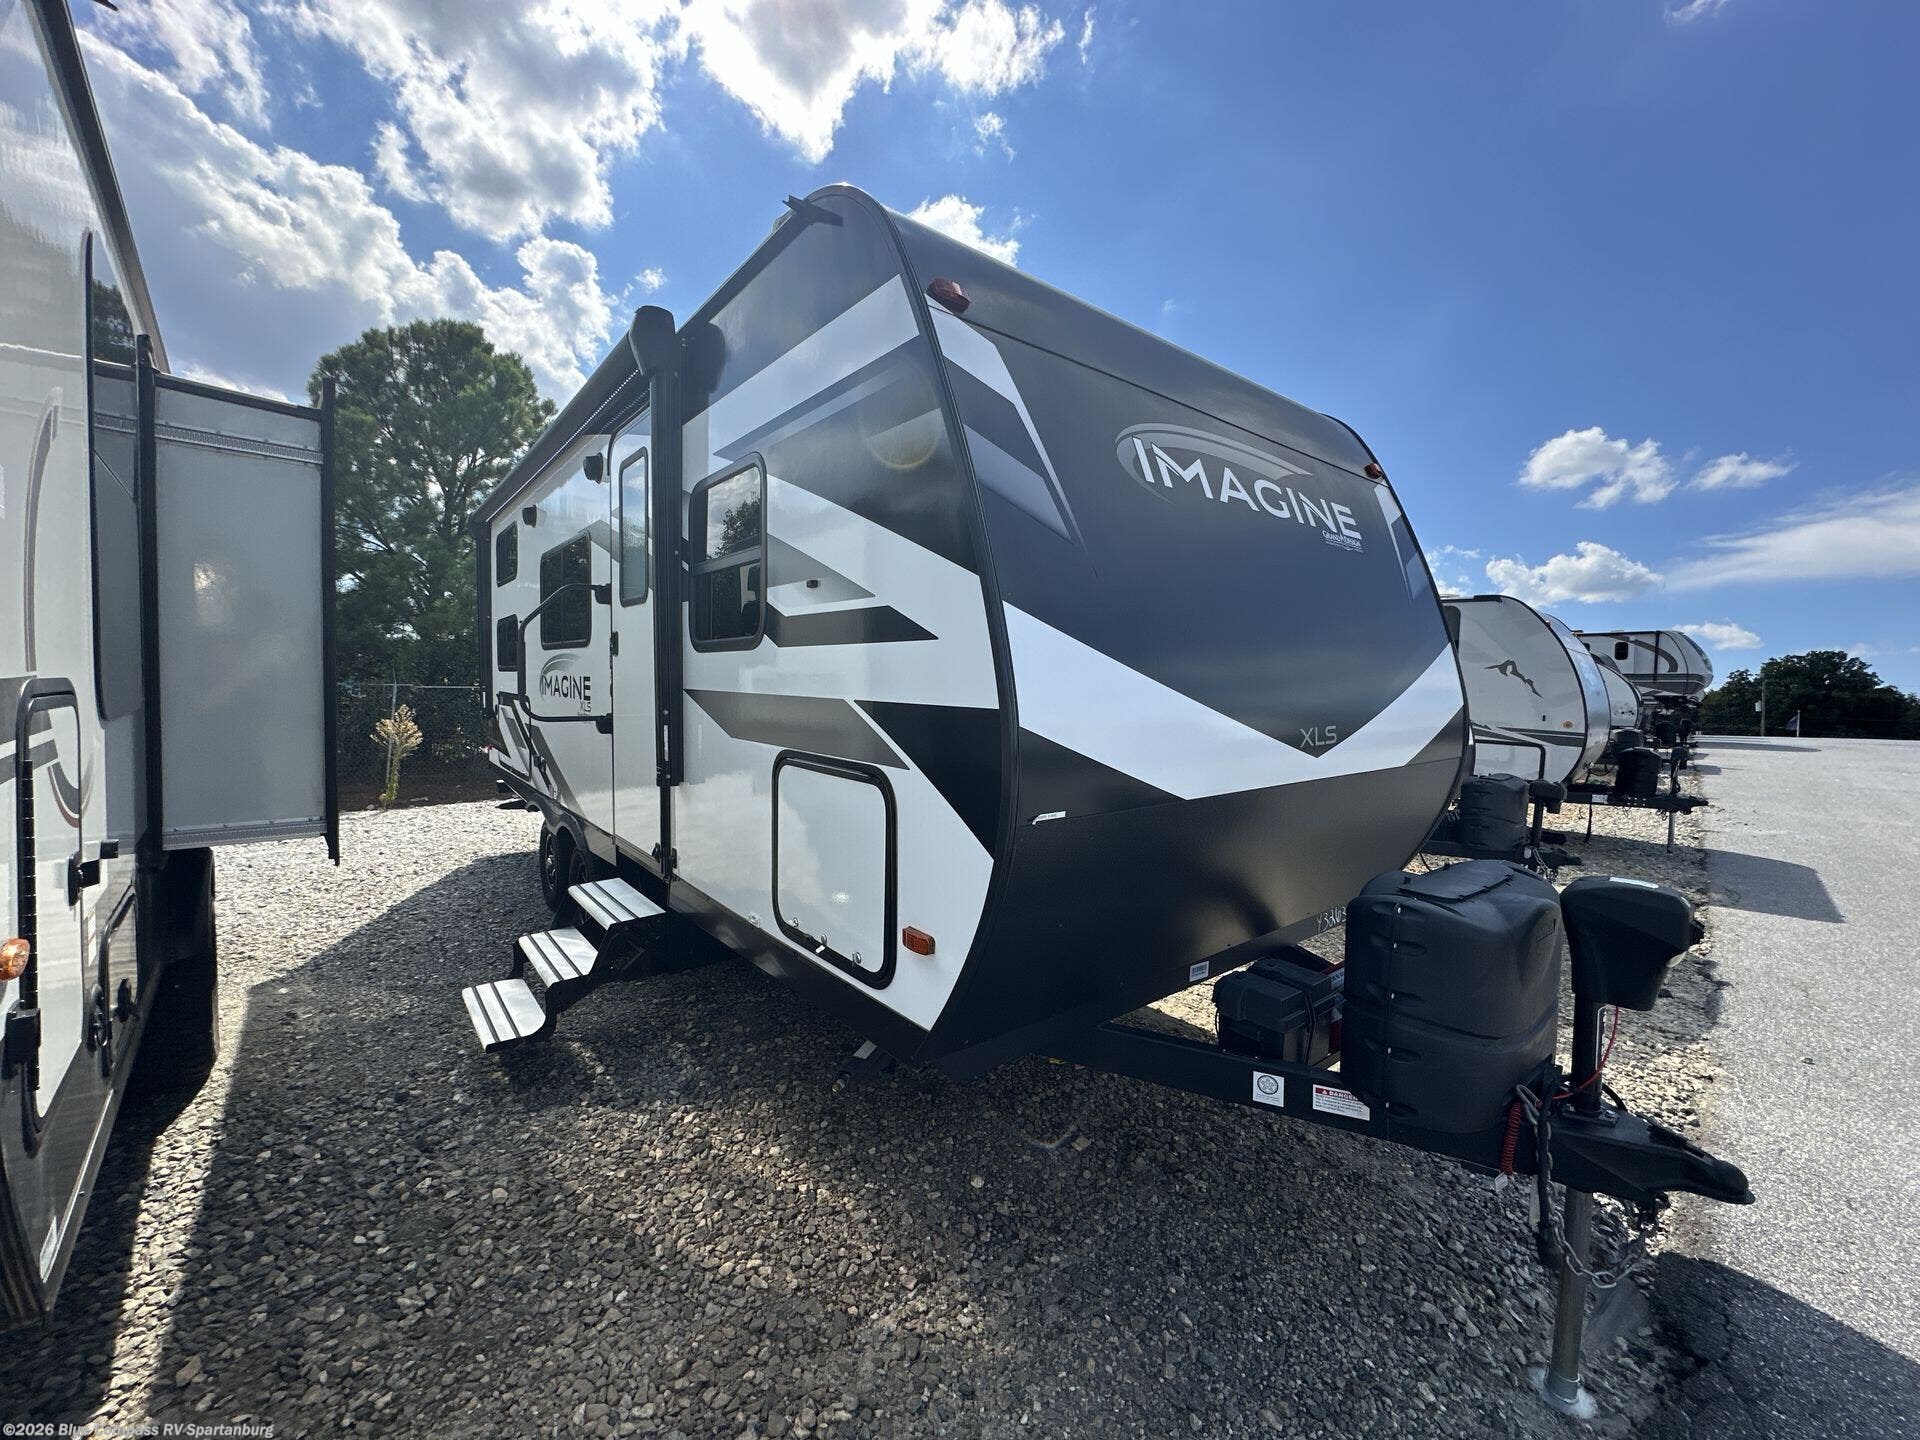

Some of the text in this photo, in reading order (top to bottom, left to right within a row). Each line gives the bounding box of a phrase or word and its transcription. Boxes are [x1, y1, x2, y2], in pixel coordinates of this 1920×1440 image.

[1132, 436, 1362, 540] IMAGINE
[541, 674, 591, 701] IMAGINE
[580, 701, 591, 712] XLS
[1300, 726, 1337, 747] XLS
